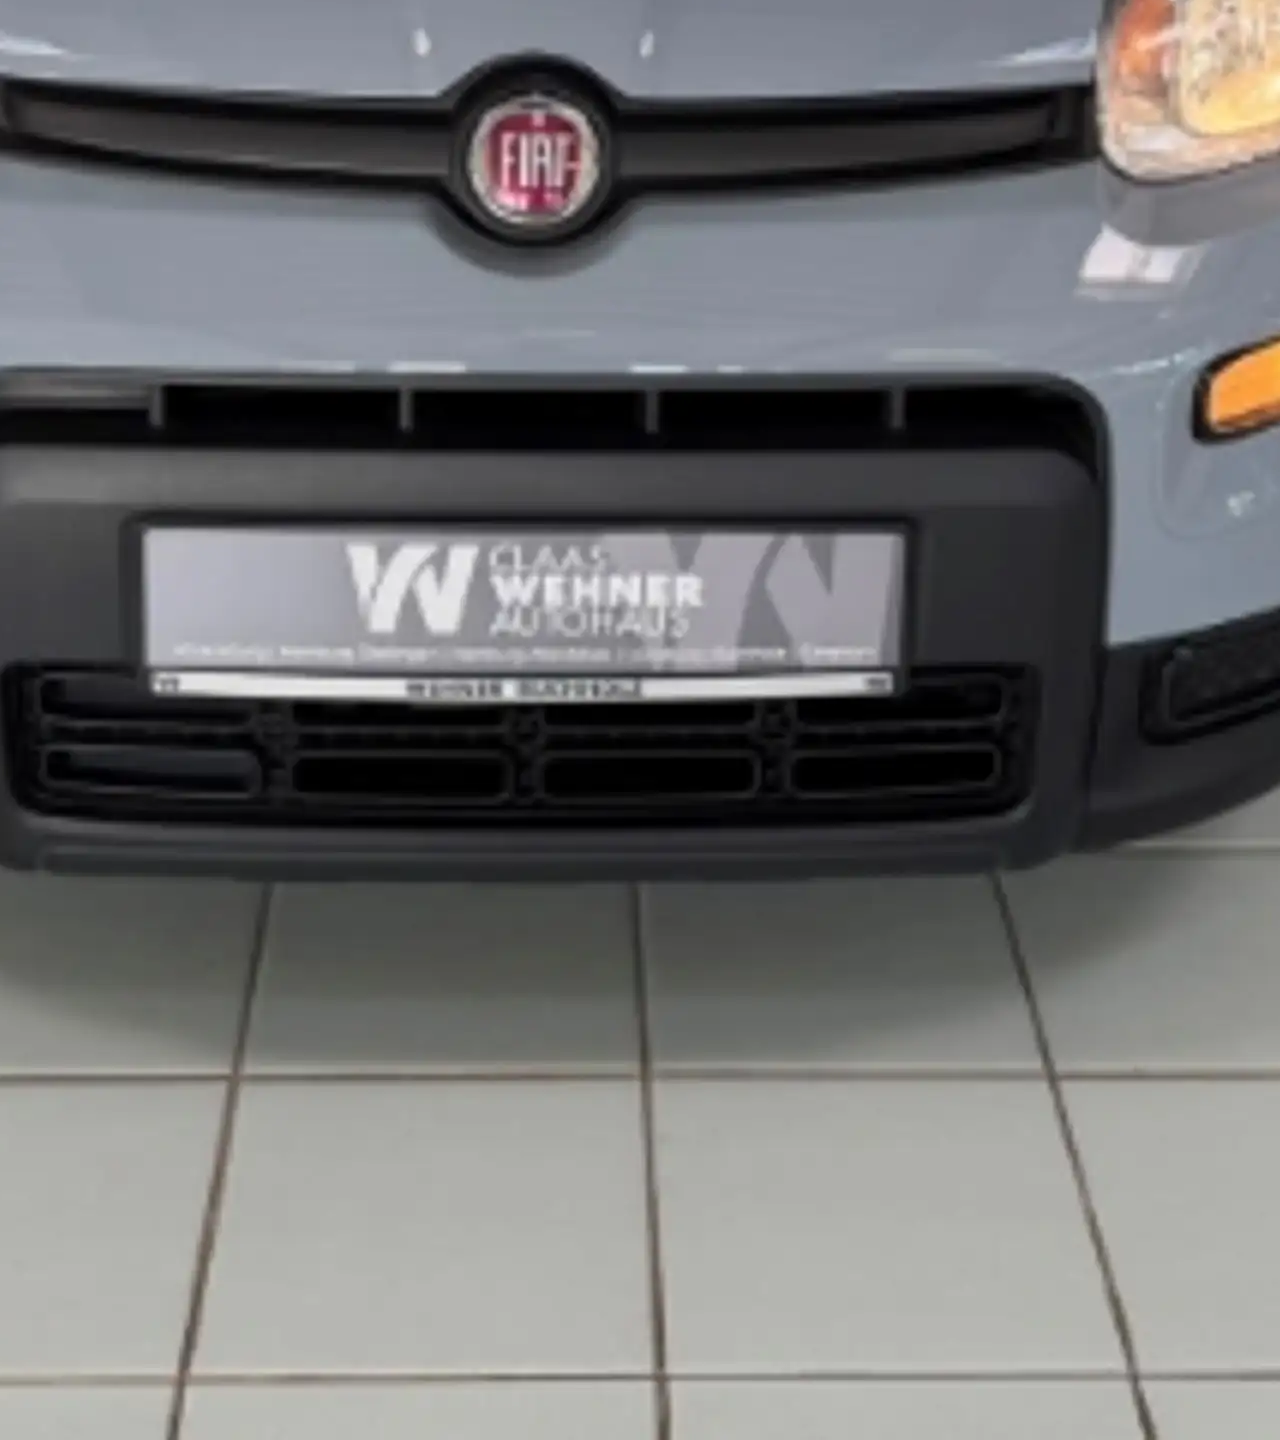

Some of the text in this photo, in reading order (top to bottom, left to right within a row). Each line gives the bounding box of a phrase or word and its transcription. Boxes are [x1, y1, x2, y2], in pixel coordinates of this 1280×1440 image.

[500, 131, 574, 188] FIAT
[487, 543, 607, 573] CLAAS
[488, 572, 704, 607] WEHNER
[488, 608, 691, 638] AUTOHAUS
